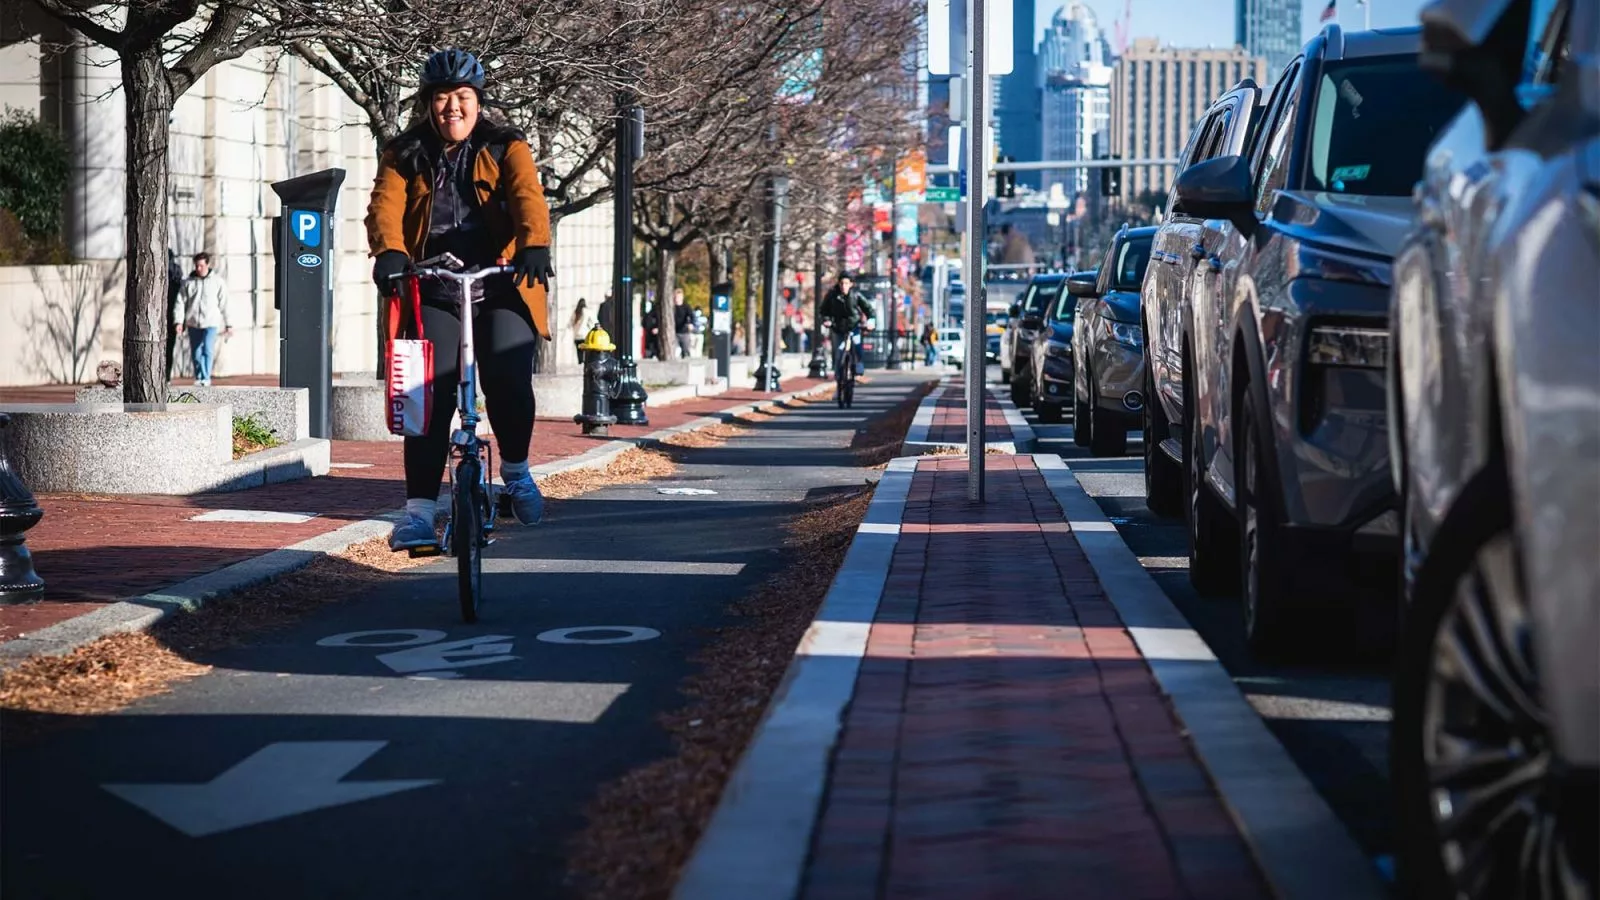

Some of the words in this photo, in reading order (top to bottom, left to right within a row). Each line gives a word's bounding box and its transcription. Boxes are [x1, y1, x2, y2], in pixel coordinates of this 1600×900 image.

[300, 214, 317, 240] P
[301, 256, 318, 264] 206
[718, 296, 727, 308] P
